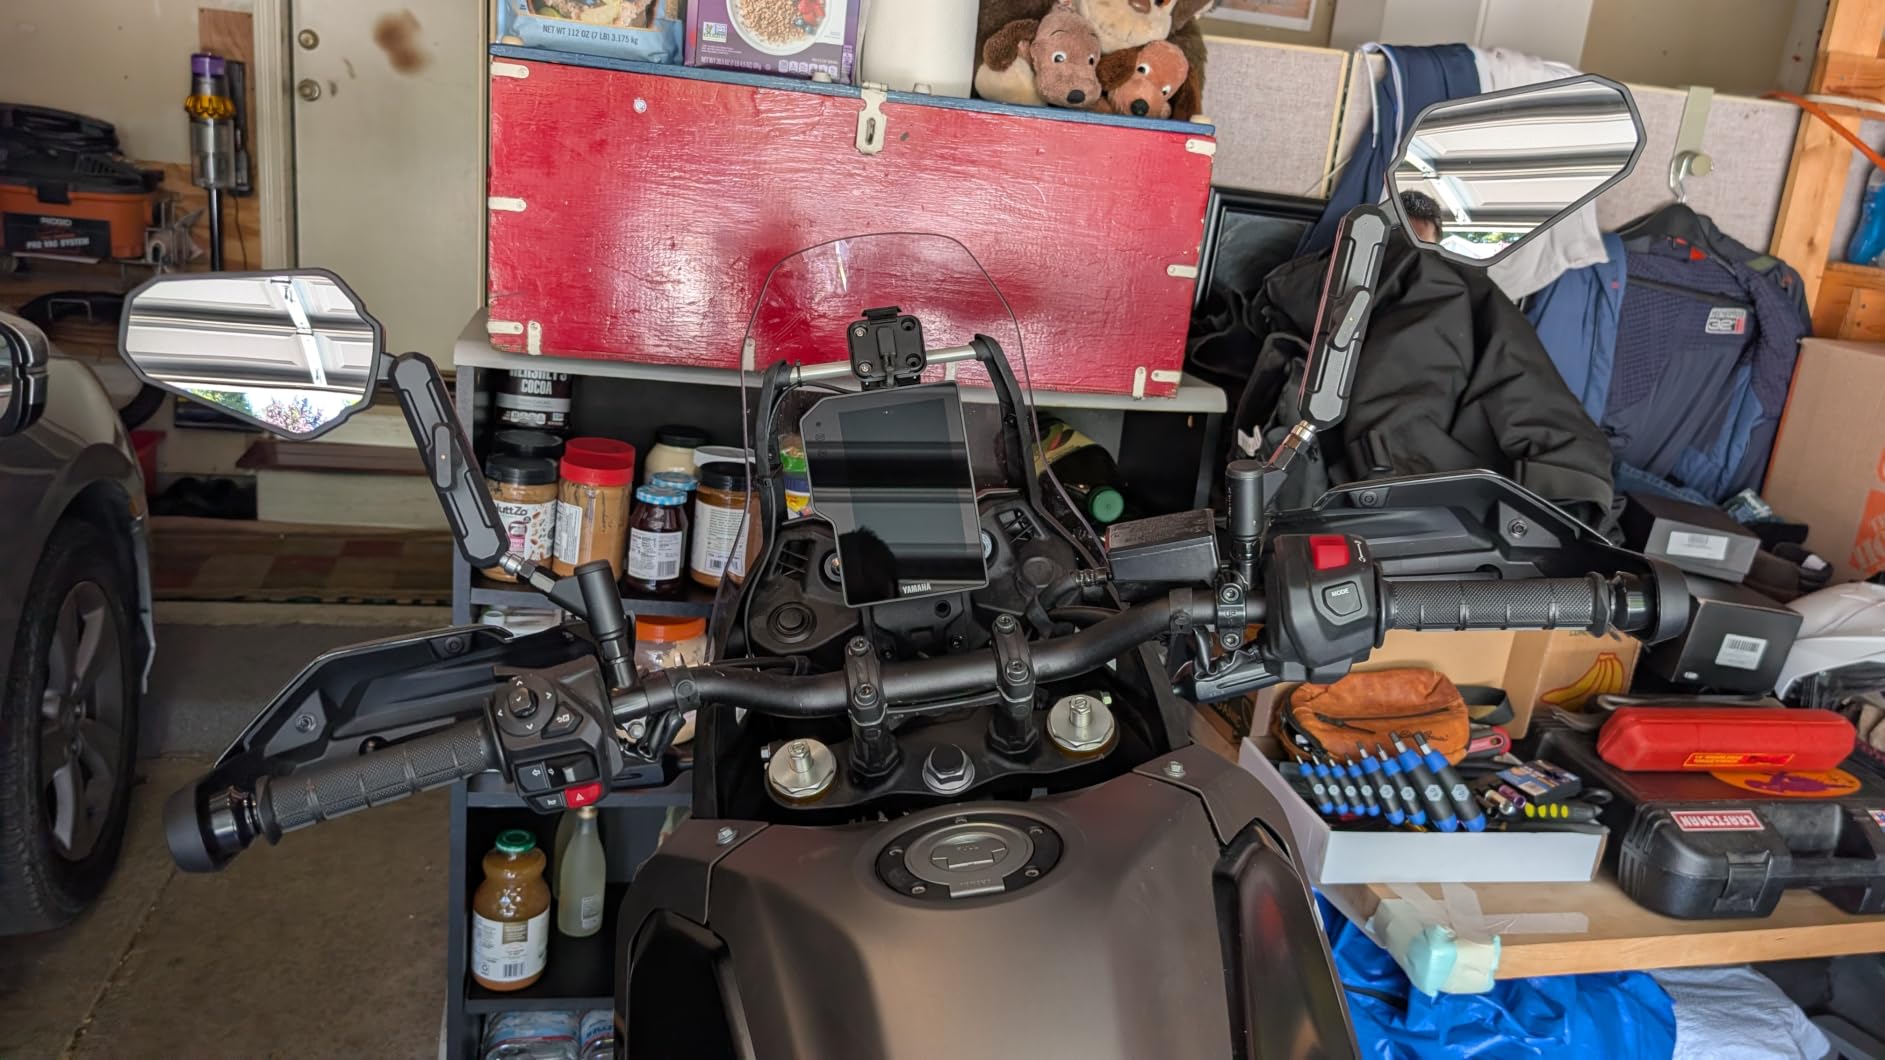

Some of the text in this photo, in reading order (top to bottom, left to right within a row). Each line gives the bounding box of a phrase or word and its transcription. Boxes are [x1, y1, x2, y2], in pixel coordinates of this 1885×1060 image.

[542, 24, 639, 46] NET WT 112 OZ (7 LB) 3.175 kg
[509, 367, 568, 382] HERSHEYS
[520, 379, 552, 395] COCOA
[902, 581, 932, 594] YAMAHA
[1331, 587, 1350, 597] MODE
[1680, 814, 1756, 827] CRAFTSMAN
